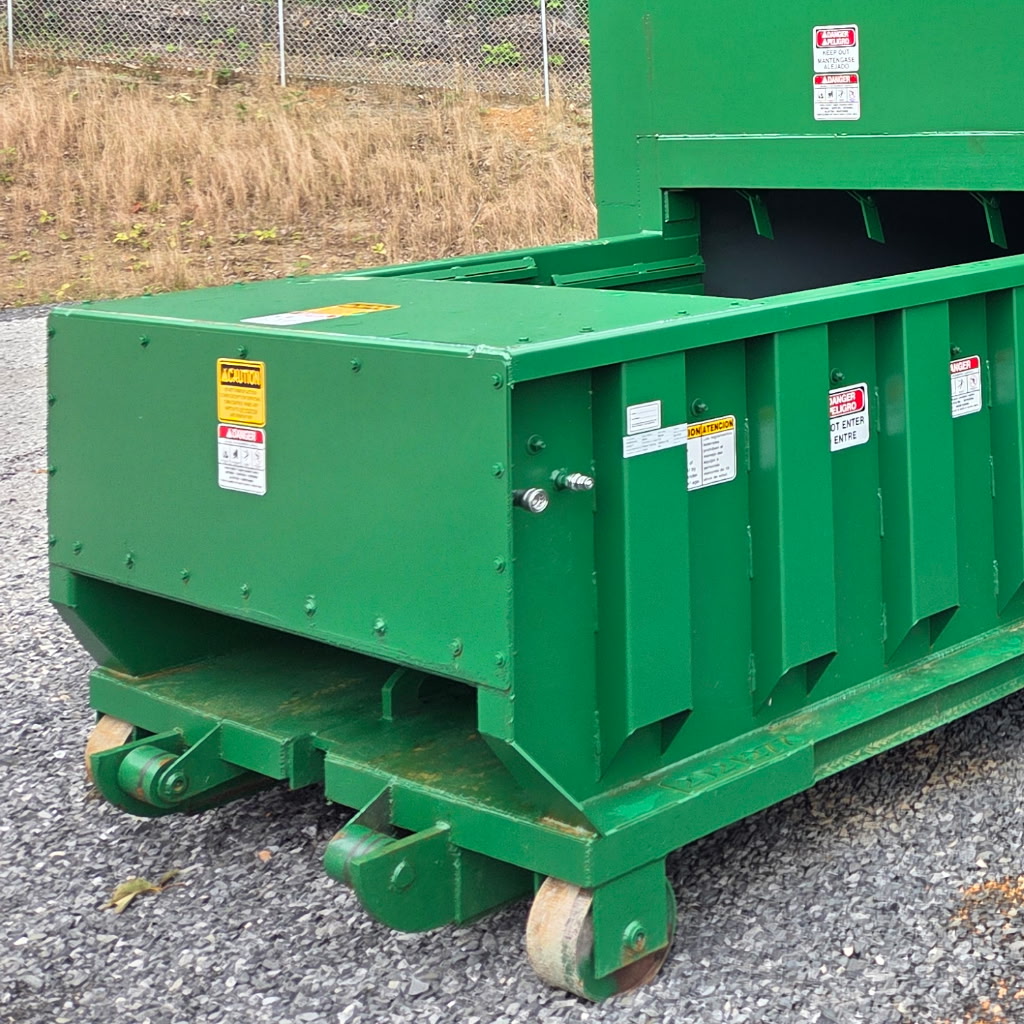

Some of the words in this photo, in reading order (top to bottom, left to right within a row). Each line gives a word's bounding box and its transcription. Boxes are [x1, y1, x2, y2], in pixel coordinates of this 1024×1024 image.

[826, 30, 849, 38] DANGER
[826, 37, 850, 46] PELIGRO
[828, 74, 850, 84] DANGER
[950, 359, 971, 373] ANGER
[229, 367, 260, 386] CAUTION
[703, 419, 733, 434] ATENCION
[830, 422, 839, 432] OT
[842, 416, 864, 429] ENTER
[834, 431, 857, 444] ENTRE
